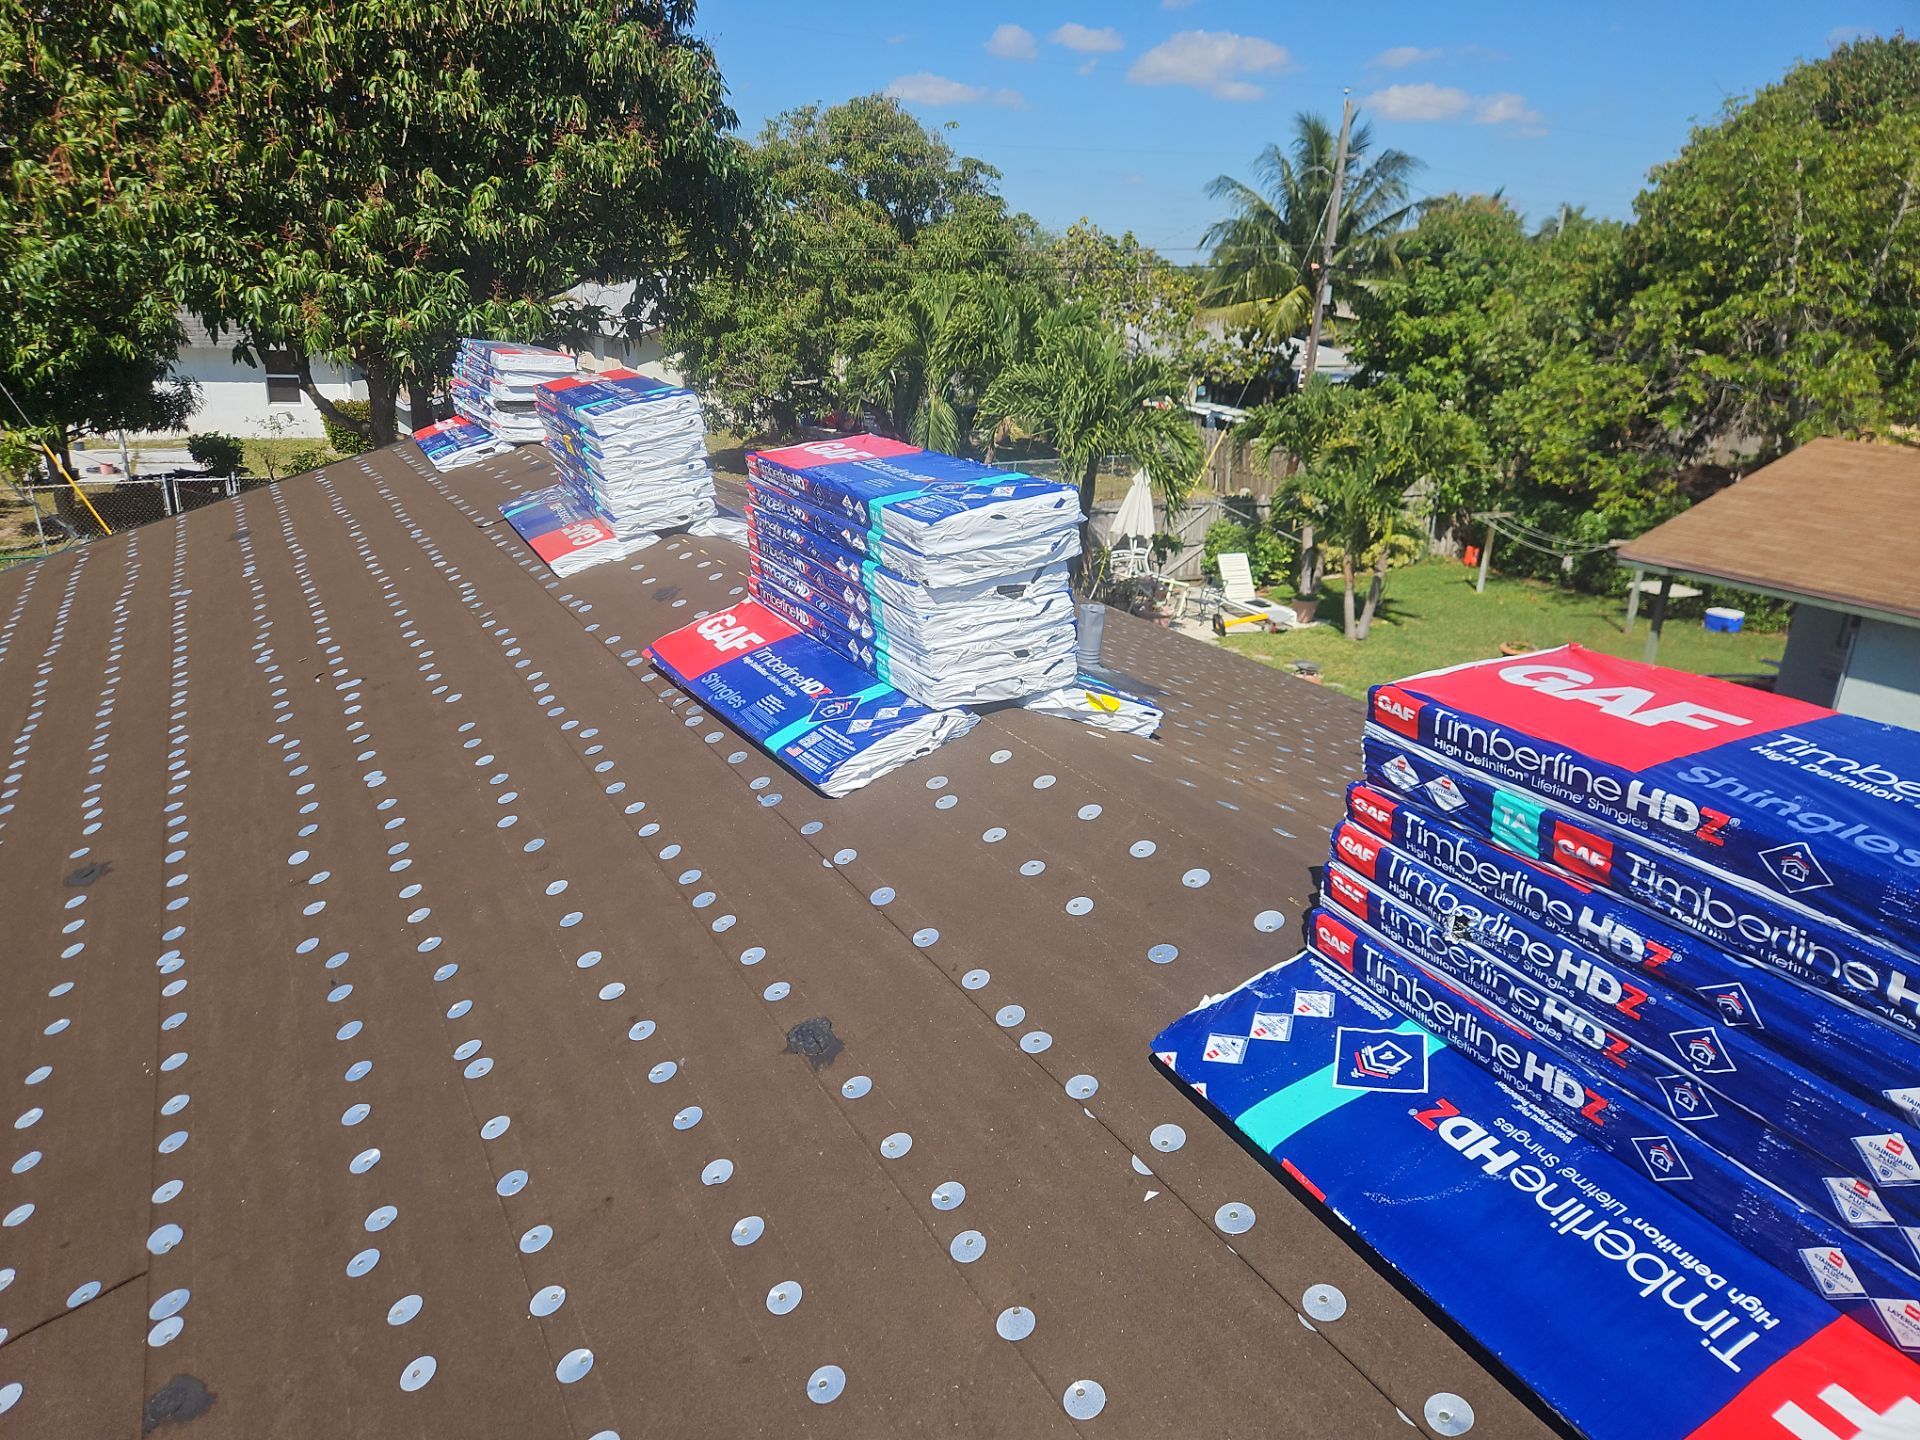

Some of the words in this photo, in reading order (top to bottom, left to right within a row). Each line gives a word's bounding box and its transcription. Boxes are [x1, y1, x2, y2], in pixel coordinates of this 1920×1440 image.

[697, 613, 766, 652] GAF
[752, 646, 804, 687] Timberline
[701, 672, 746, 708] Shingles
[1377, 695, 1416, 722] GAF
[1498, 664, 1753, 731] GAF
[1434, 707, 1622, 801] Timberline
[1750, 745, 1799, 766] High
[1433, 737, 1463, 759] High
[1587, 796, 1649, 831] Shingles
[1353, 798, 1391, 823] GAF
[1500, 805, 1532, 833] TA
[1677, 765, 1920, 868] Shingles
[1340, 835, 1376, 862] GAF
[1402, 811, 1573, 925] Timberline
[1405, 840, 1432, 863] High
[1557, 838, 1606, 867] GAF
[1388, 880, 1413, 902] High
[1389, 851, 1555, 967] Timberline
[1318, 926, 1351, 954] GAF
[1626, 850, 1880, 992] Timberline
[1379, 898, 1539, 1011] Timberline
[1366, 974, 1390, 996] High
[1380, 922, 1405, 944] High
[1511, 1003, 1562, 1041] Shingles
[1362, 942, 1521, 1069] Timberline
[1493, 1117, 1560, 1167] Shingles
[1868, 1141, 1914, 1171] STAINGUARD
[1510, 1164, 1760, 1373] Timberline
[1727, 1287, 1780, 1331] High
